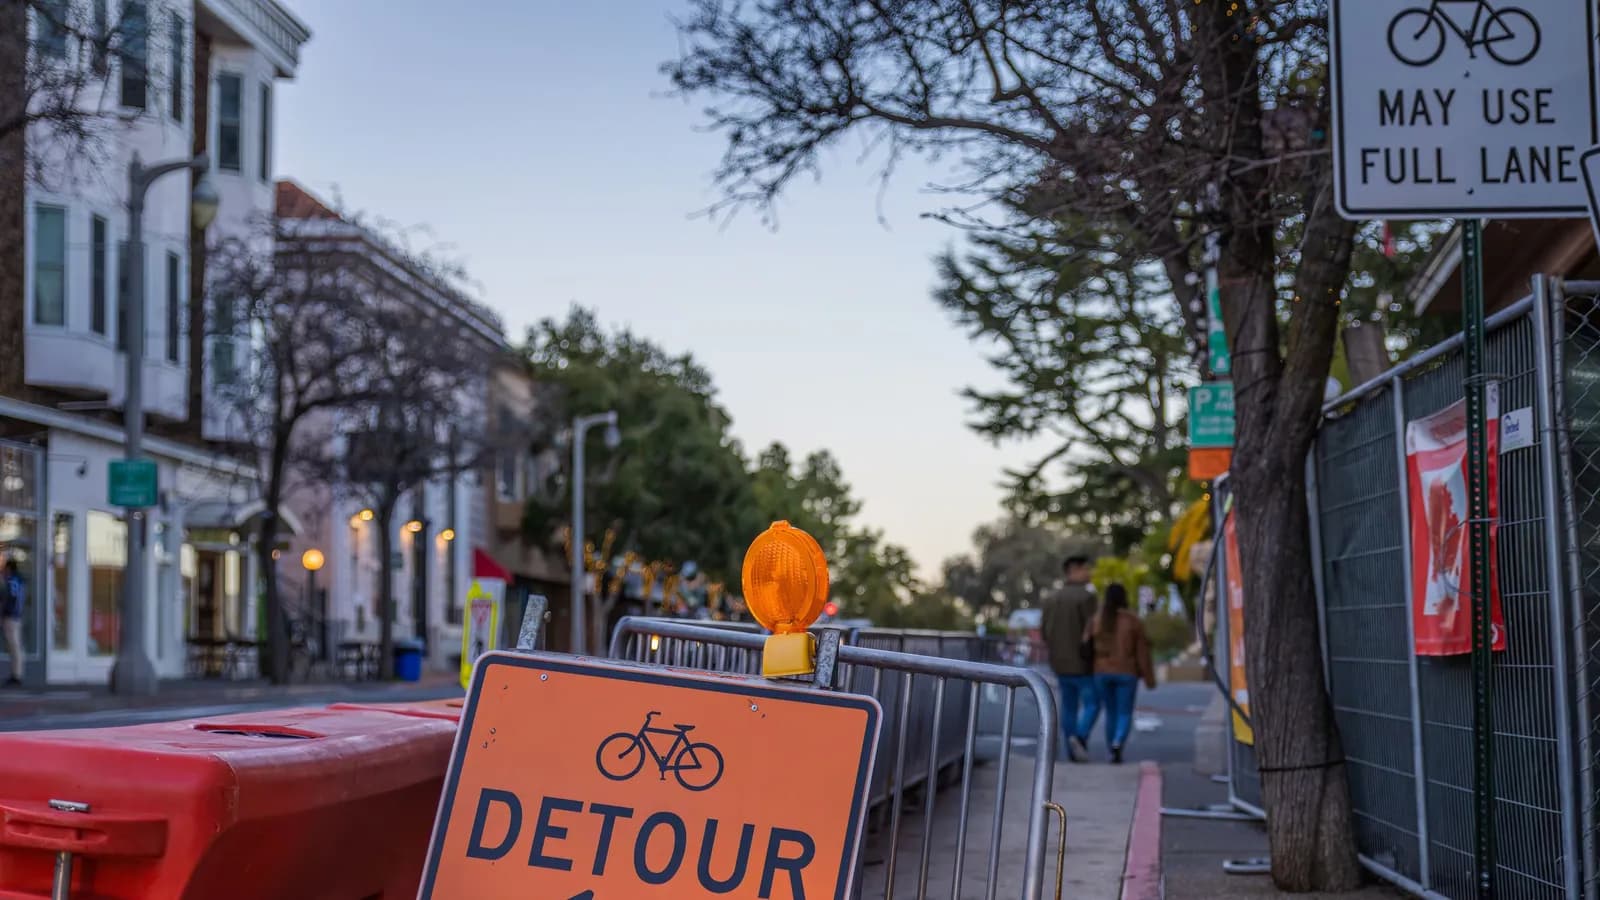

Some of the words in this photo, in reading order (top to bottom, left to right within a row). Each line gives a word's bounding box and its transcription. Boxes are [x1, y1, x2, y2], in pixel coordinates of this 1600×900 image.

[1378, 88, 1456, 127] MAY
[1482, 87, 1556, 125] USE
[1360, 147, 1457, 185] FULL
[1480, 145, 1578, 184] LANE
[465, 786, 817, 900] DETOUR
